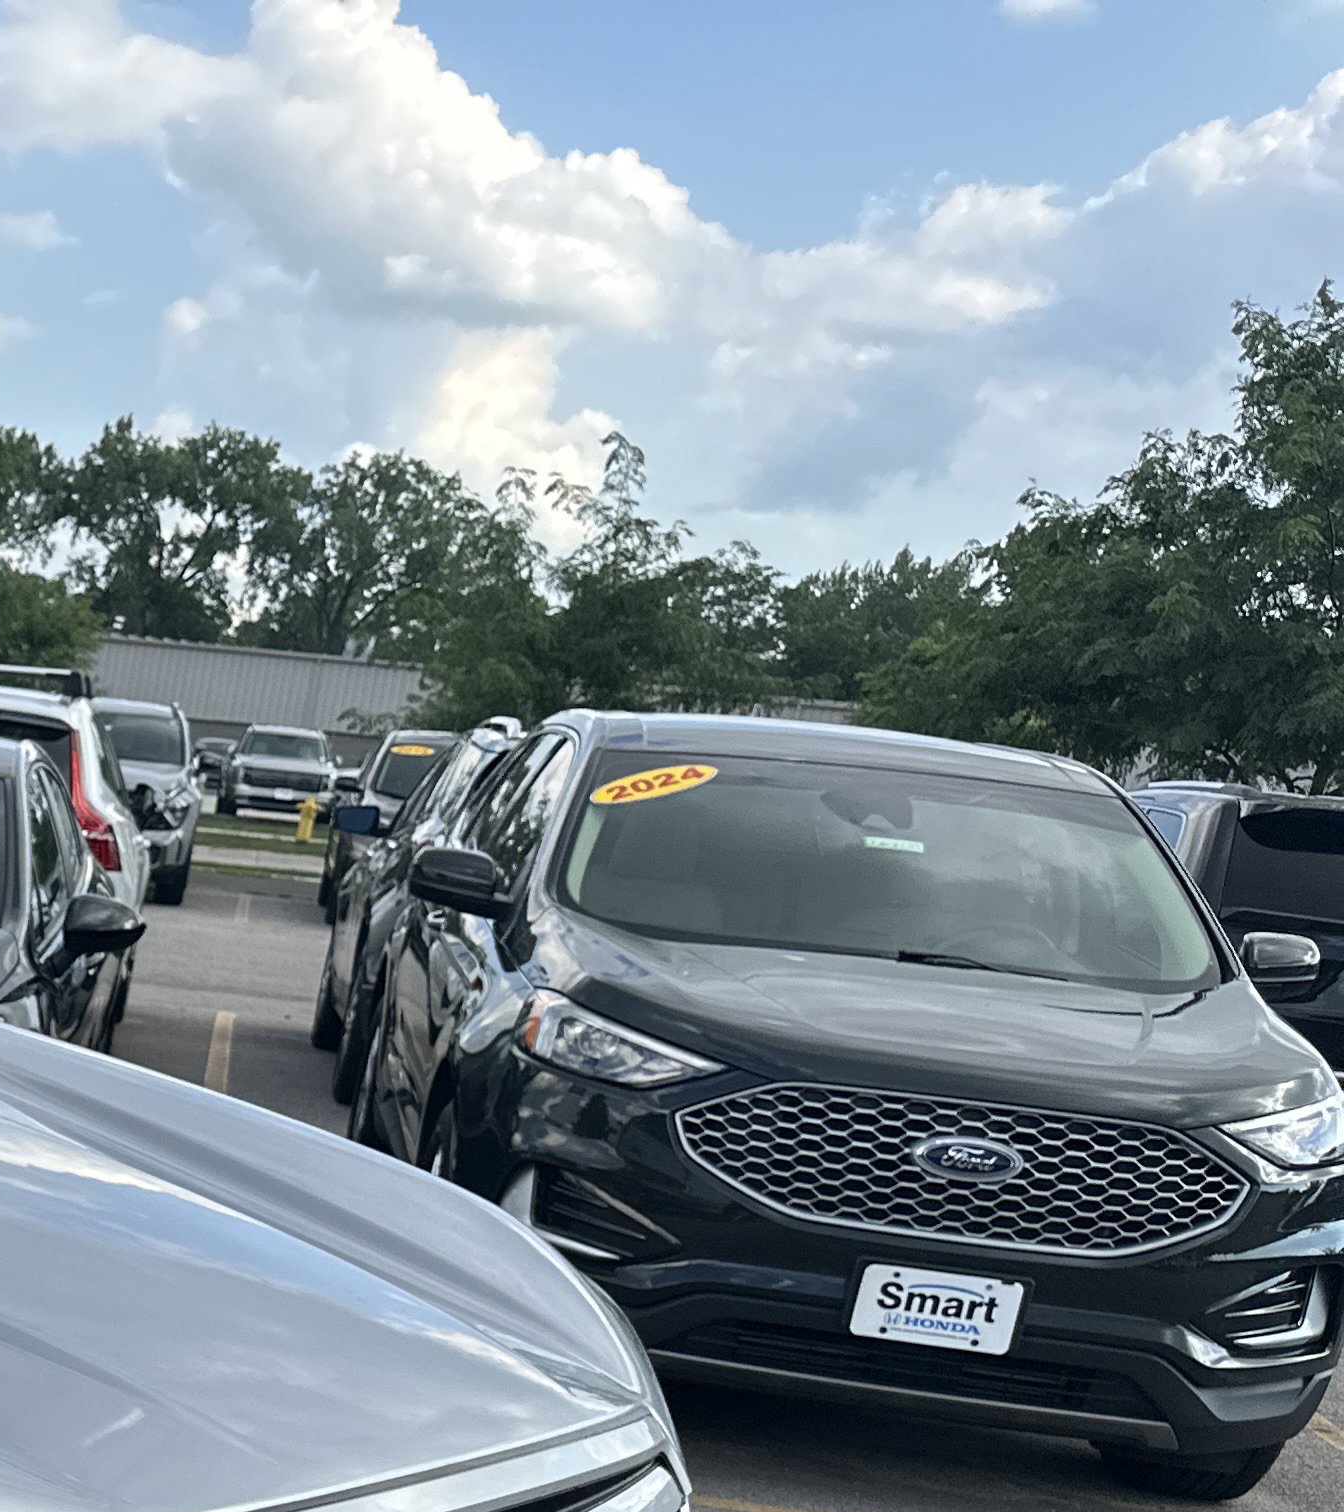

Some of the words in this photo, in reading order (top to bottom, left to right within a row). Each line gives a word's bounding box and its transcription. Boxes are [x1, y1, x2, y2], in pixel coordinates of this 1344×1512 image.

[605, 767, 705, 801] 2024
[940, 1145, 998, 1172] Ford
[876, 1281, 999, 1324] Smart
[903, 1315, 981, 1336] HONDA
